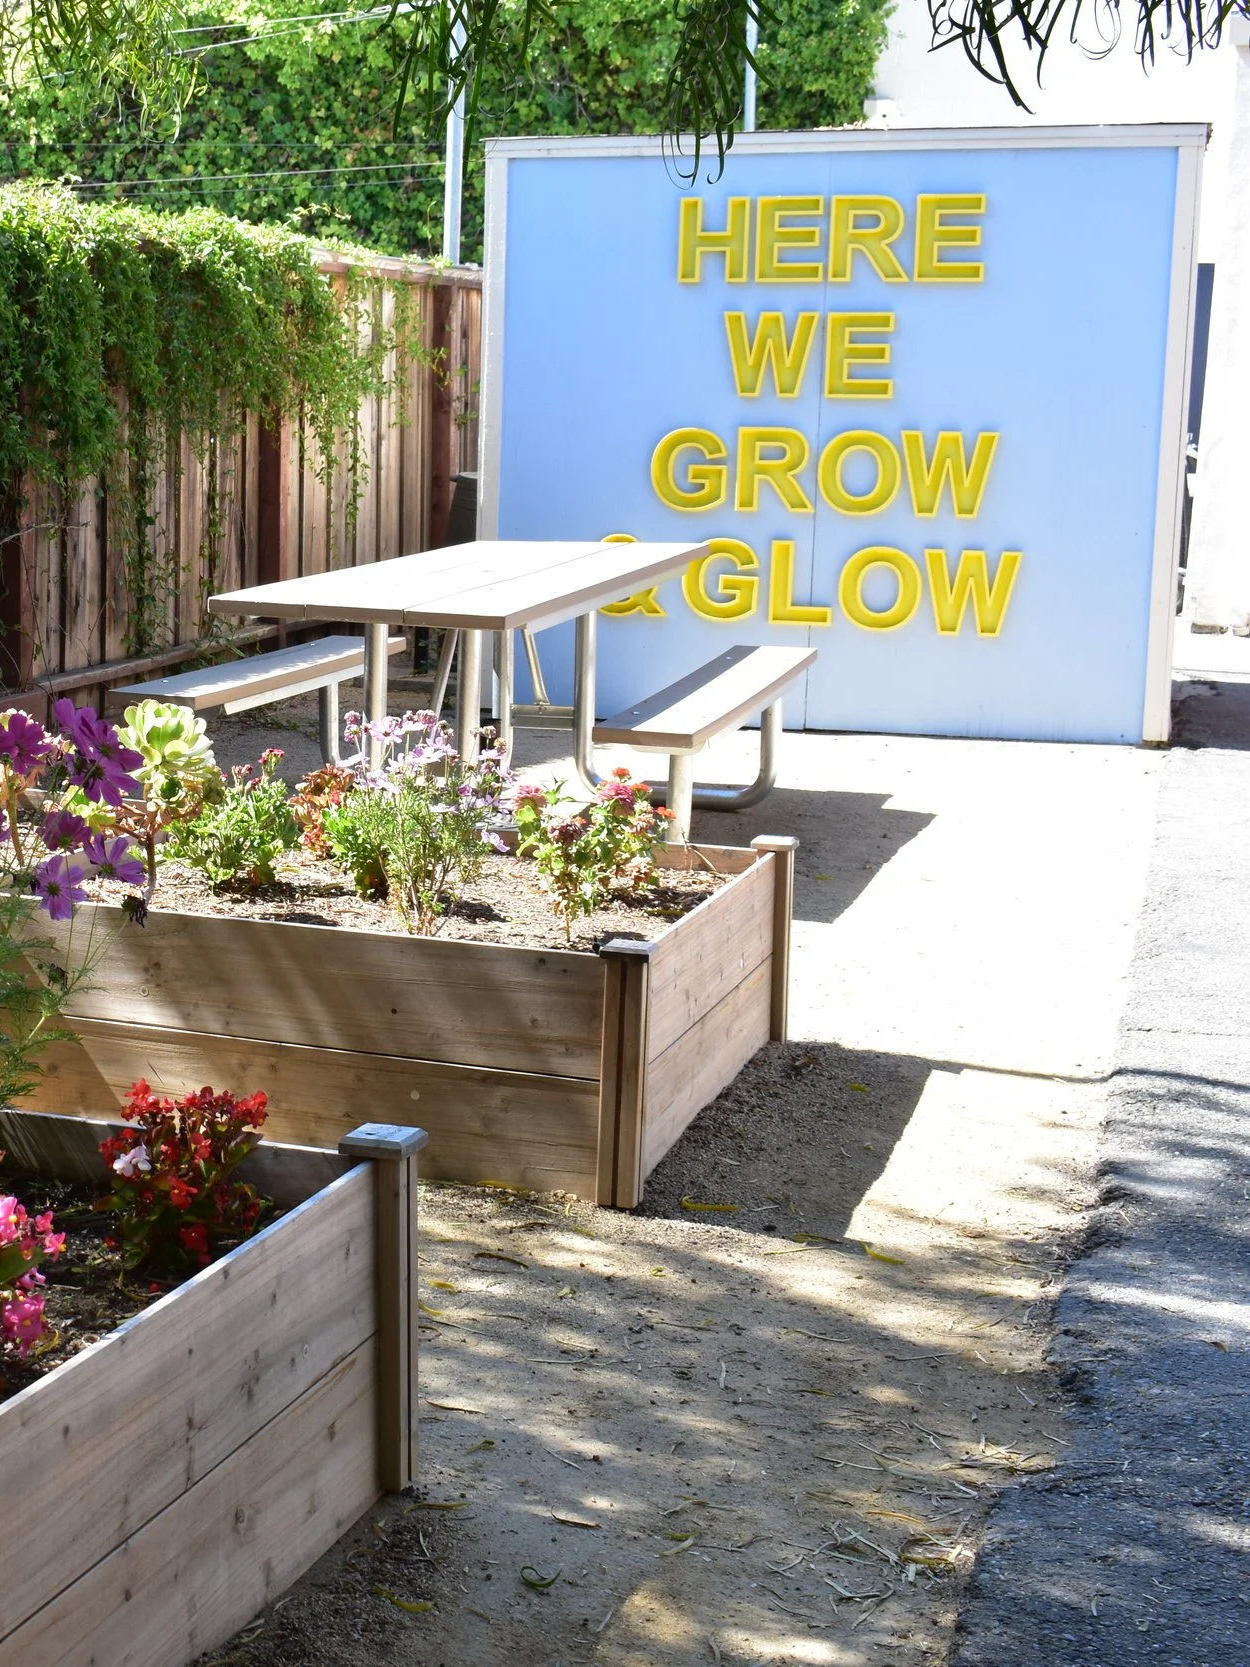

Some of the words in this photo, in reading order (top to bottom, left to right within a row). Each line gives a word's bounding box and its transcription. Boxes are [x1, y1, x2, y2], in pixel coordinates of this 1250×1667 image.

[678, 193, 986, 283] HERE
[724, 312, 895, 399] WE
[651, 427, 999, 518] GROW
[681, 537, 1022, 637] GLOW
